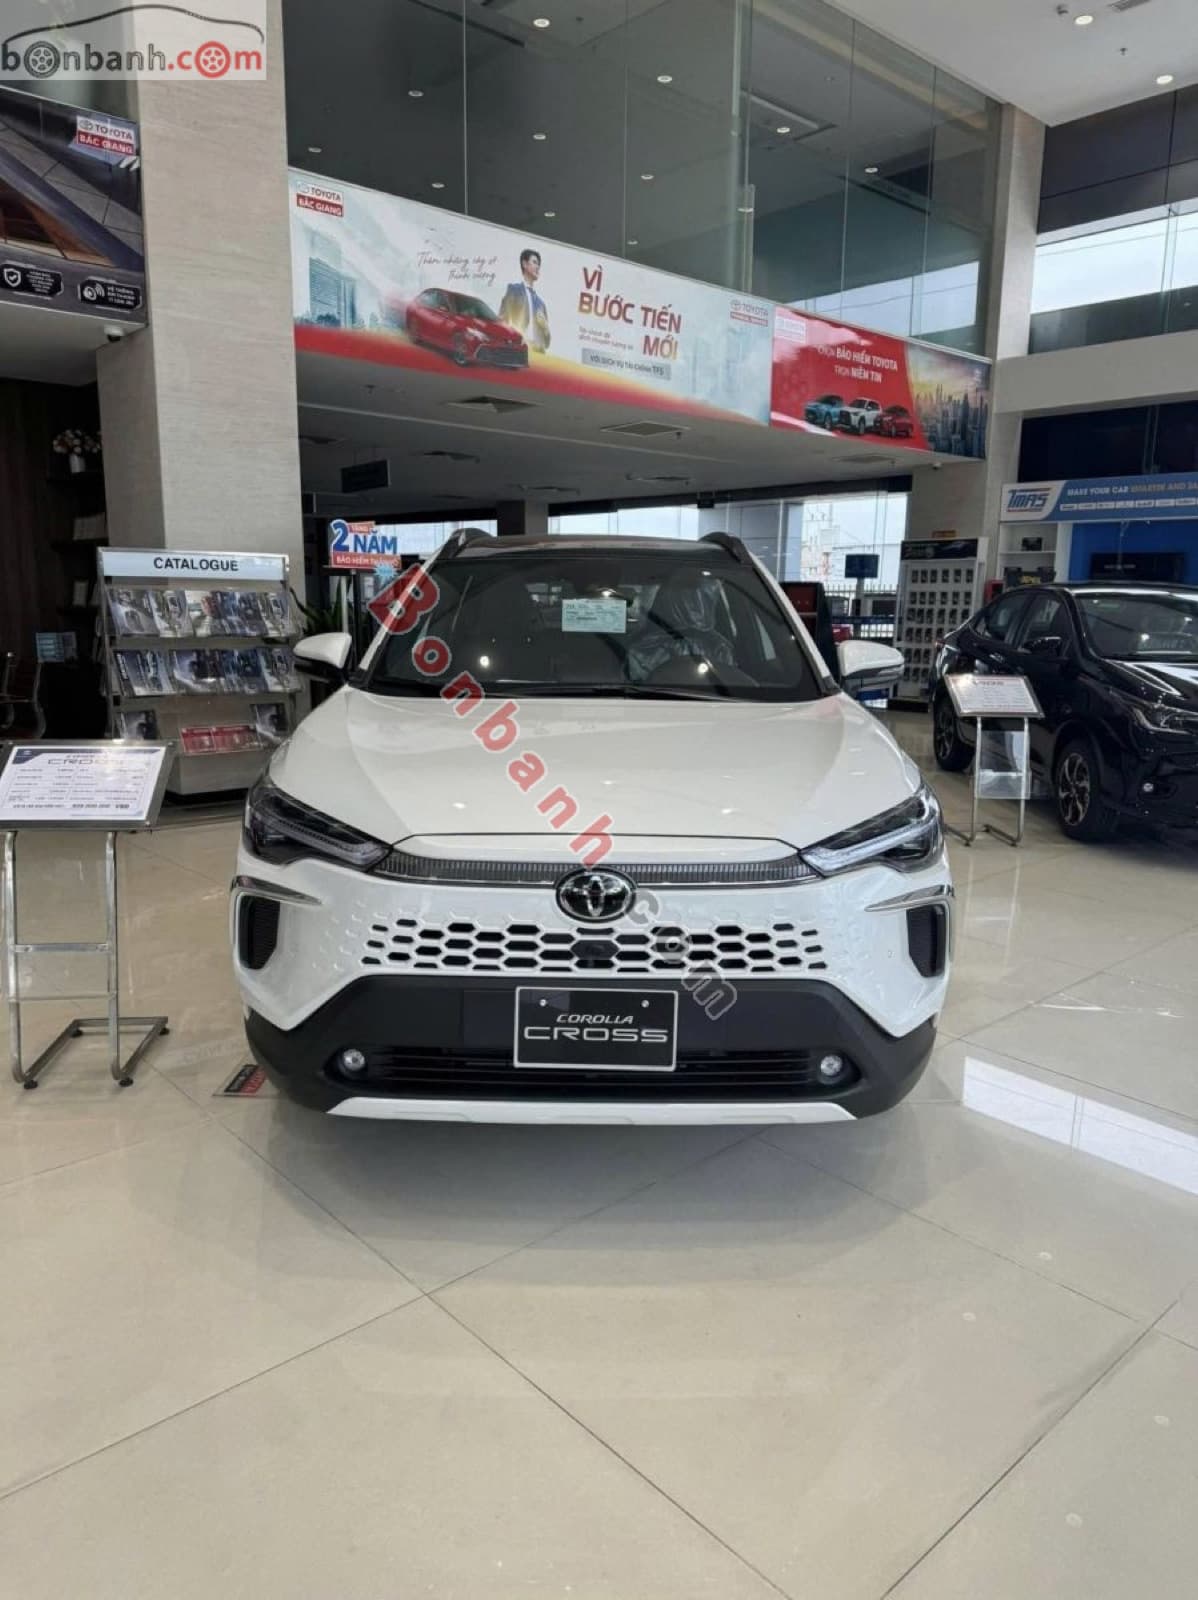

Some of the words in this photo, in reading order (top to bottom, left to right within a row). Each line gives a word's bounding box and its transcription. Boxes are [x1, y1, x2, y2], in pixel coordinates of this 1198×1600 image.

[94, 124, 133, 140] TOYOTA
[311, 187, 342, 201] TOYOTA
[583, 264, 603, 292] VÌ
[578, 292, 635, 324] BƯỚC
[641, 303, 682, 334] TIẾN
[642, 334, 678, 360] MỚI
[872, 355, 898, 372] TOYOTA
[1112, 485, 1129, 494] CAR
[333, 521, 349, 552] 2
[353, 530, 398, 555] NĂM
[153, 556, 240, 572] CATALOGUE
[556, 1014, 634, 1025] COROLLA
[523, 1026, 669, 1043] CROSS
